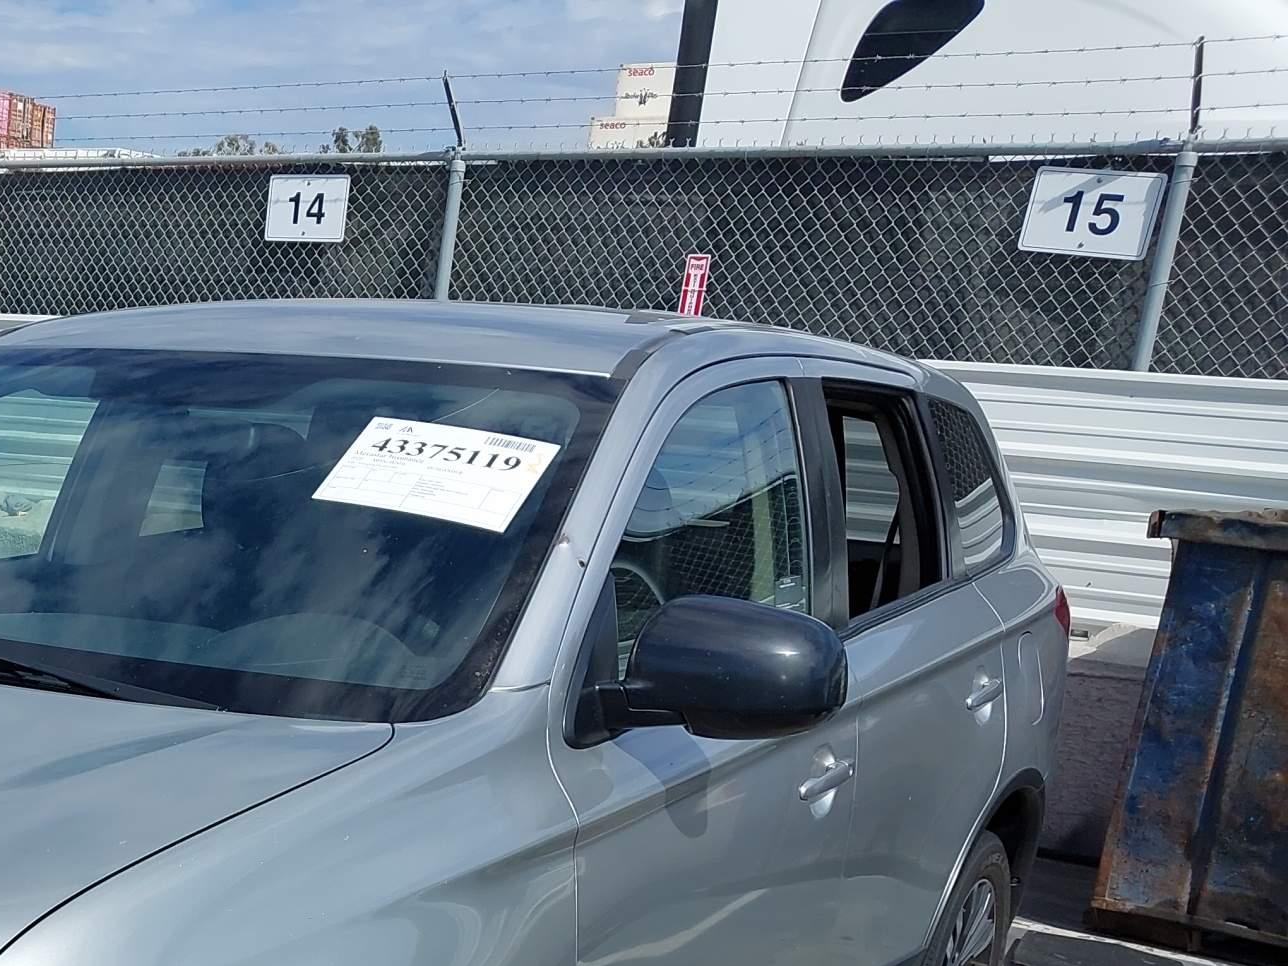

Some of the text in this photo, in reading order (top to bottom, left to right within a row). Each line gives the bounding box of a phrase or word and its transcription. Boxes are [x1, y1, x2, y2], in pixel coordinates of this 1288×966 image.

[627, 67, 655, 77] seaco
[599, 121, 626, 130] seaco
[288, 191, 325, 225] 14
[1063, 190, 1125, 236] 15
[690, 263, 705, 271] FIRE
[371, 437, 522, 471] 43375119
